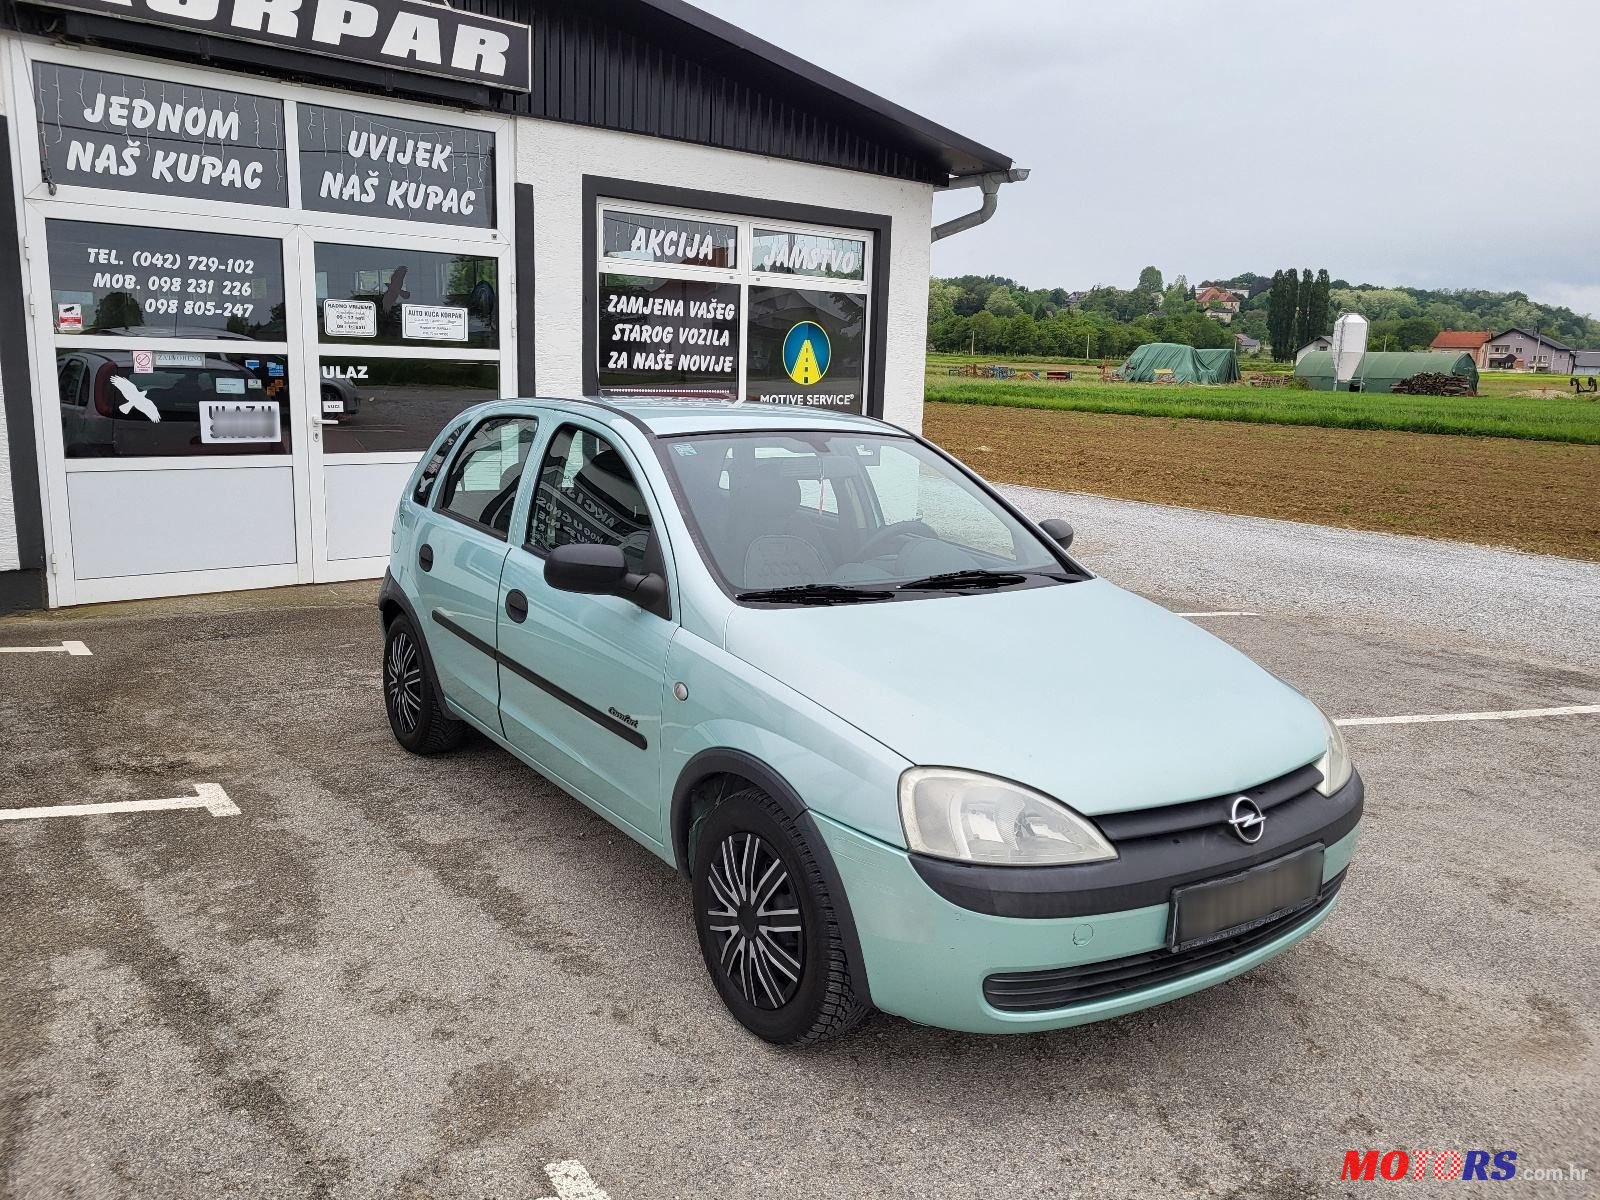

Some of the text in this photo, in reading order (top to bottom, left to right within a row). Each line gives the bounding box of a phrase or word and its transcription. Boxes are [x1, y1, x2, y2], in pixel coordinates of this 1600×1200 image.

[83, 93, 240, 141] JEDNOM
[66, 140, 264, 190] NAŠ KUPAC
[347, 130, 452, 173] UVIJEK
[319, 169, 476, 216] NAŠ KUPAC
[631, 227, 714, 261] AKCIJA
[763, 240, 857, 275] JAMSTVO
[87, 247, 255, 275] TEL. (042) 729-102
[92, 272, 252, 297] MOB. 098 231 226
[144, 298, 254, 318] 098 805-247
[607, 294, 735, 321] ZAMJENA VAŠEG
[611, 323, 730, 347] STAROG VOZILA
[321, 365, 369, 379] ULAZ
[607, 348, 734, 373] ZA NAŠE NOVIJE
[760, 394, 804, 405] MOTIVE
